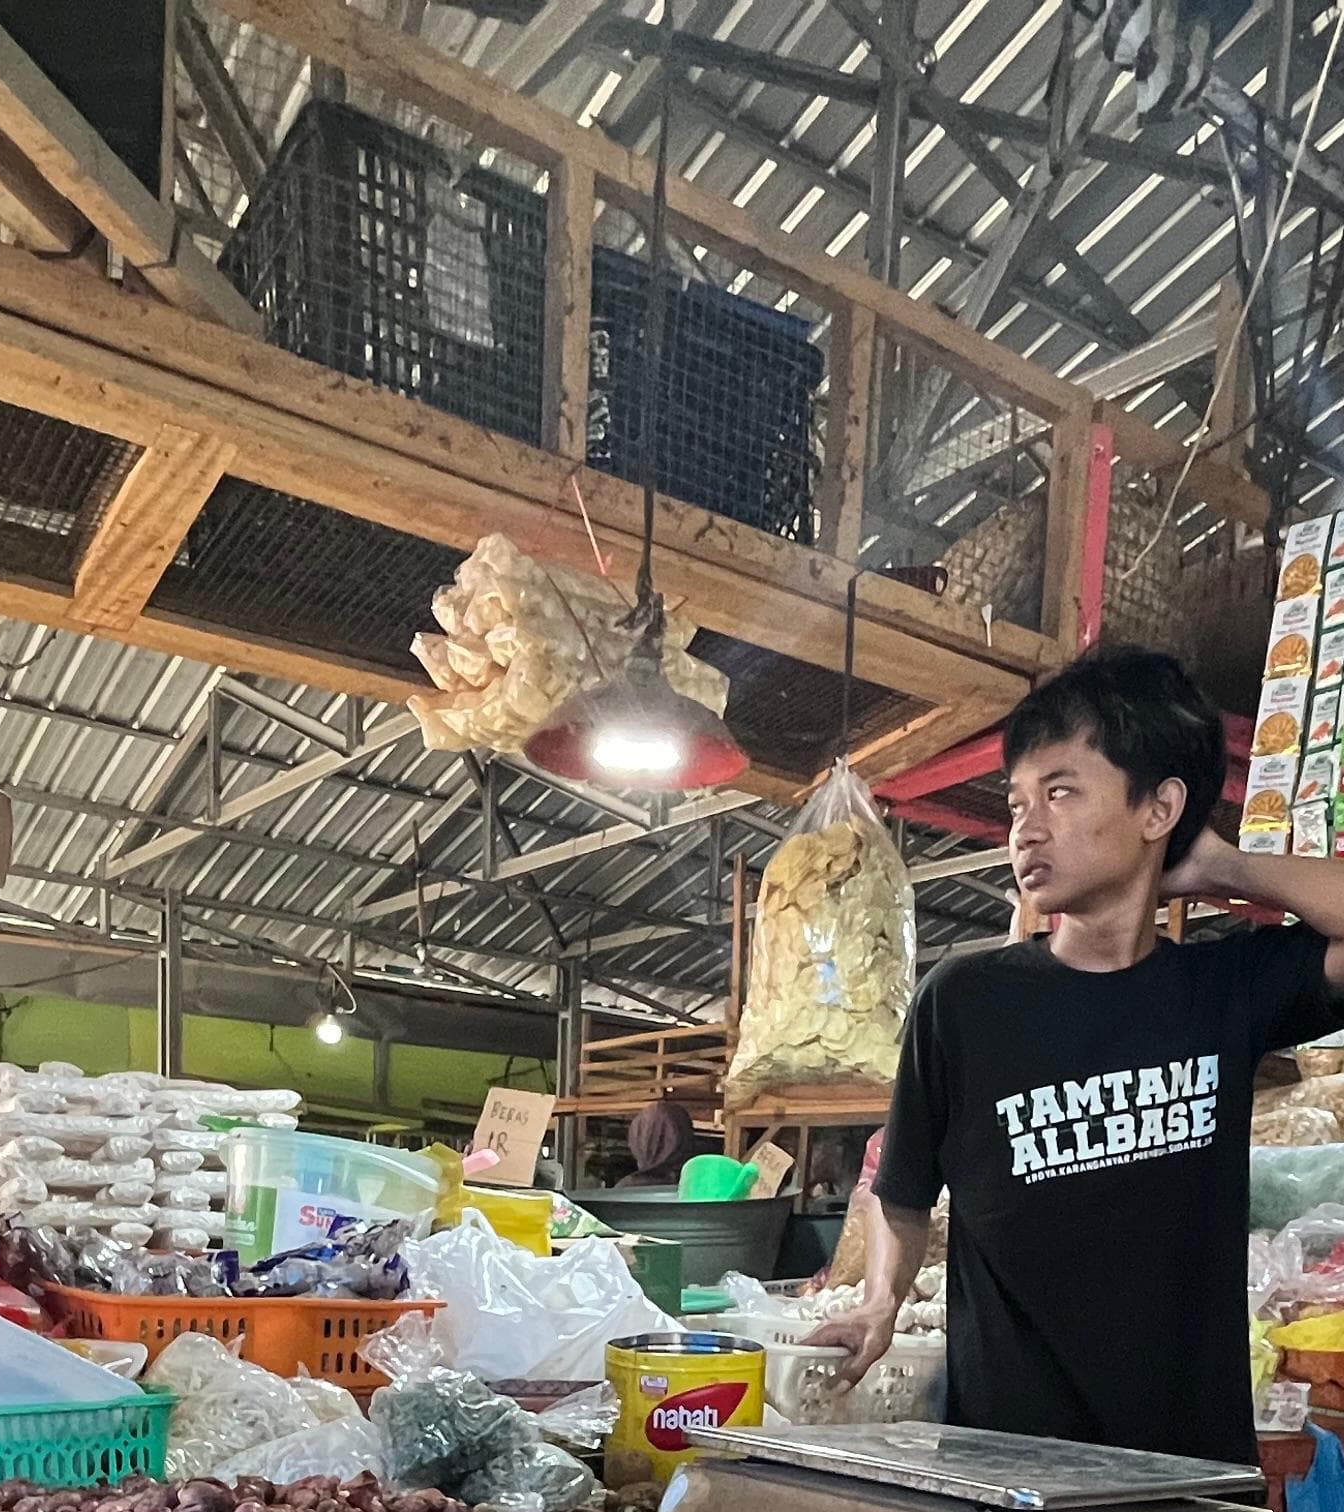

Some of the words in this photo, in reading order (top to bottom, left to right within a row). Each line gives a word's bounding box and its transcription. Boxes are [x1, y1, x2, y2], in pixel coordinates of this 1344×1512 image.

[490, 1101, 529, 1126] BERAS
[995, 1054, 1219, 1136] TAMTAMA
[1010, 1095, 1216, 1176] ALLBASE
[653, 1405, 718, 1431] nabati
